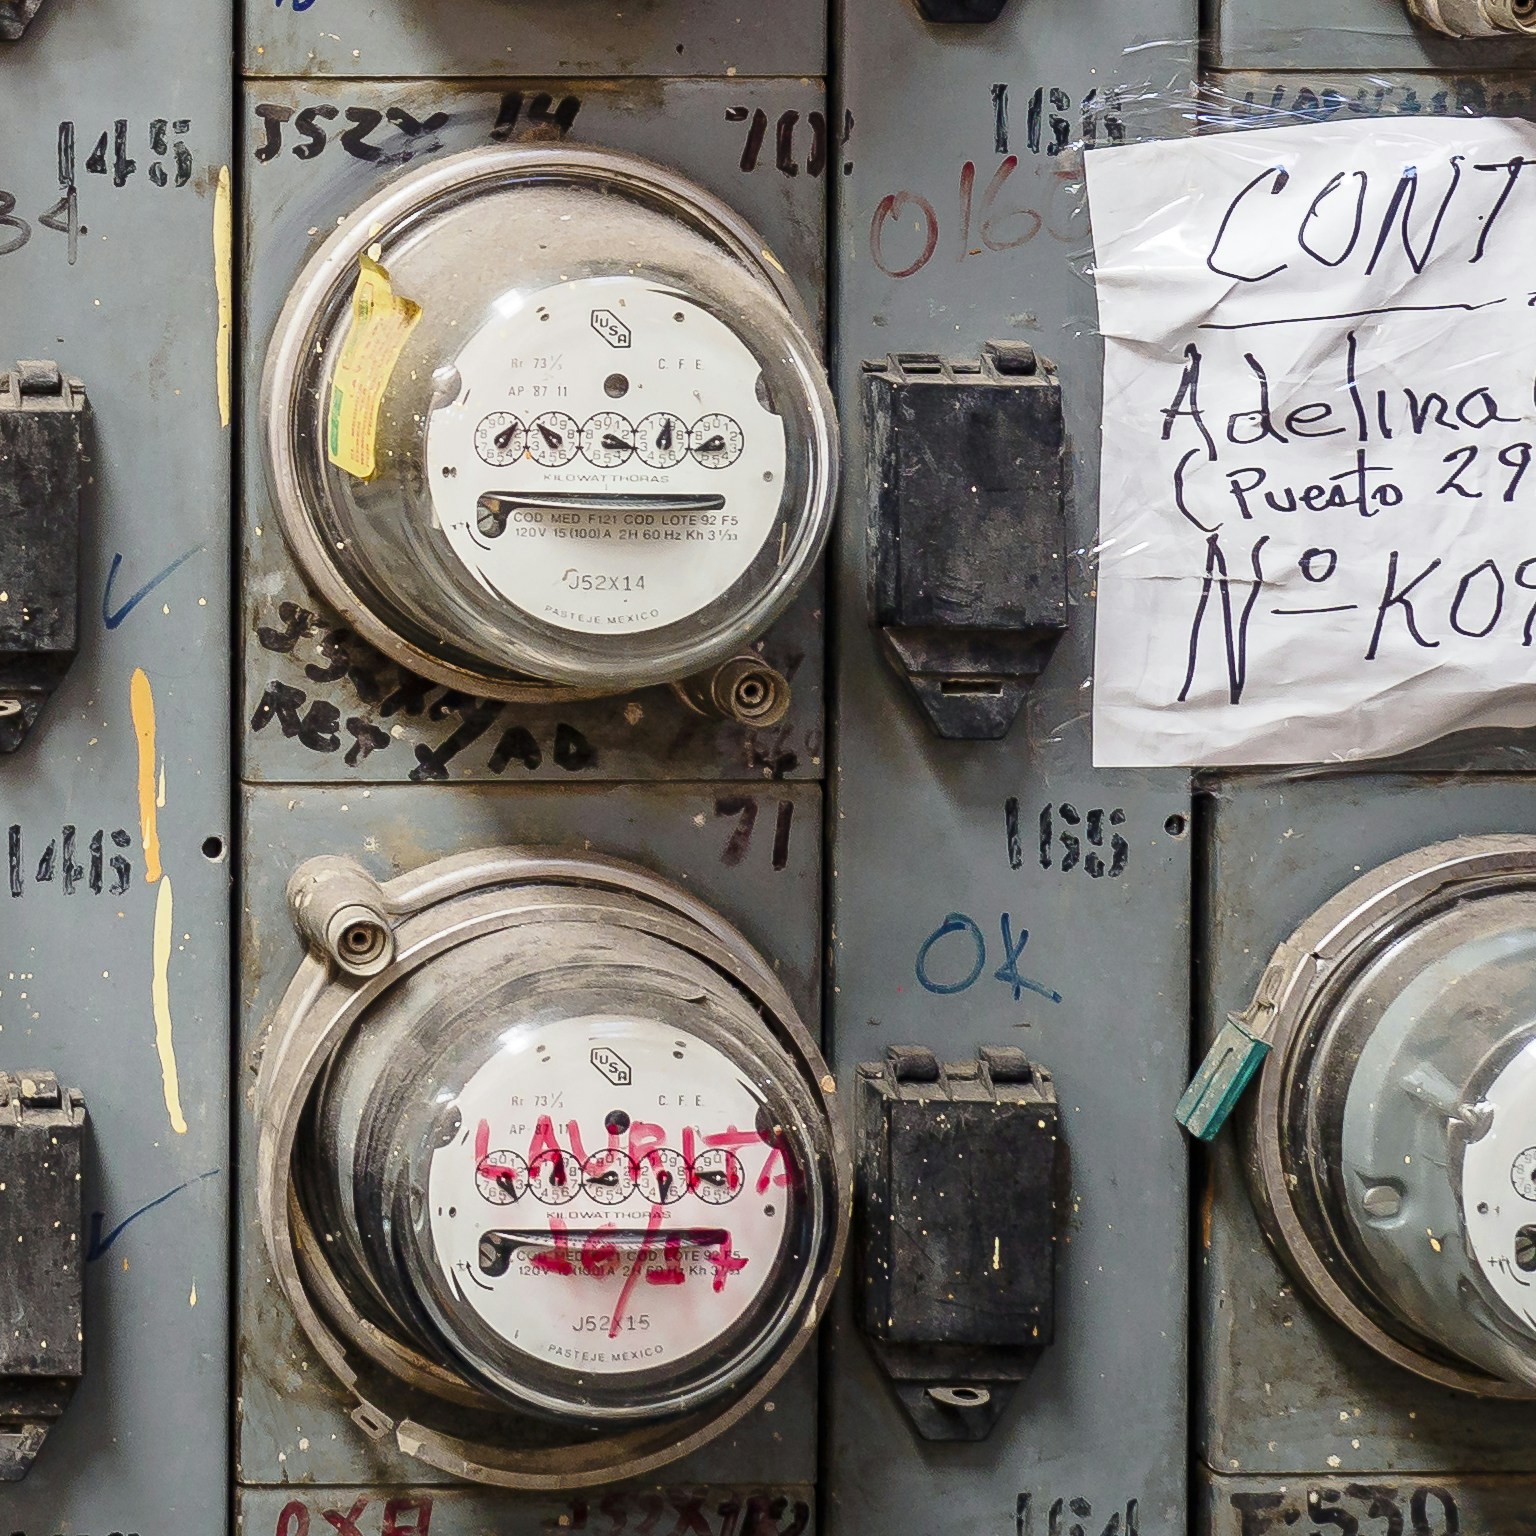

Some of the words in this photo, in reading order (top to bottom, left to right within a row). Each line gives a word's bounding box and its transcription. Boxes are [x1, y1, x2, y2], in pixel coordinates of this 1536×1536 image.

[595, 314, 628, 344] IUSA
[1160, 330, 1522, 462] Adelina
[543, 474, 669, 484] KILOWATTHORAS
[567, 574, 645, 592] J52X14
[714, 797, 795, 872] 71
[915, 910, 1063, 1003] OK
[594, 1050, 629, 1082] IUSA
[546, 1210, 672, 1220] KILOWATTHORAS
